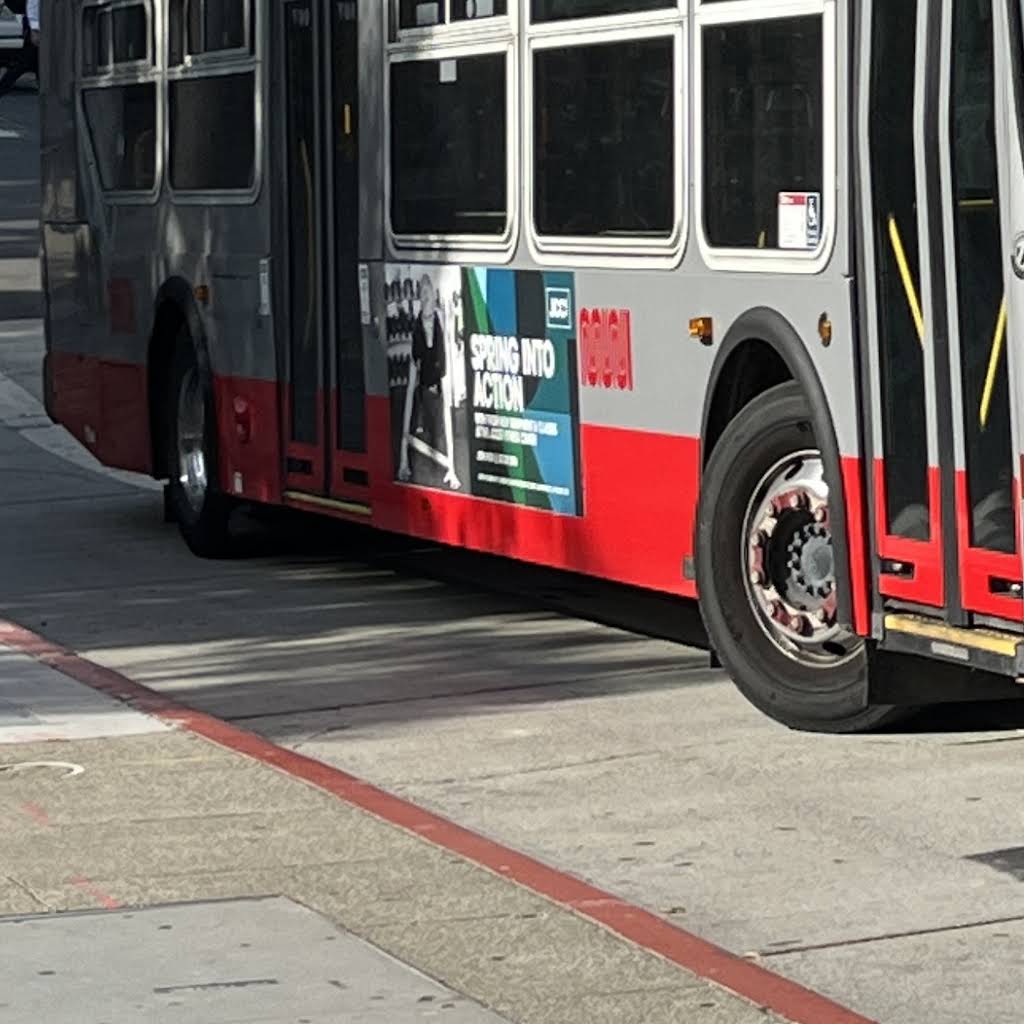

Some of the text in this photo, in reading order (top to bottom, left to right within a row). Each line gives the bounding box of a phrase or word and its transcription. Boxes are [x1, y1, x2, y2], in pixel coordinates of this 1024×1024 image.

[470, 333, 555, 379] SPRING INTO
[473, 370, 524, 412] ACTION
